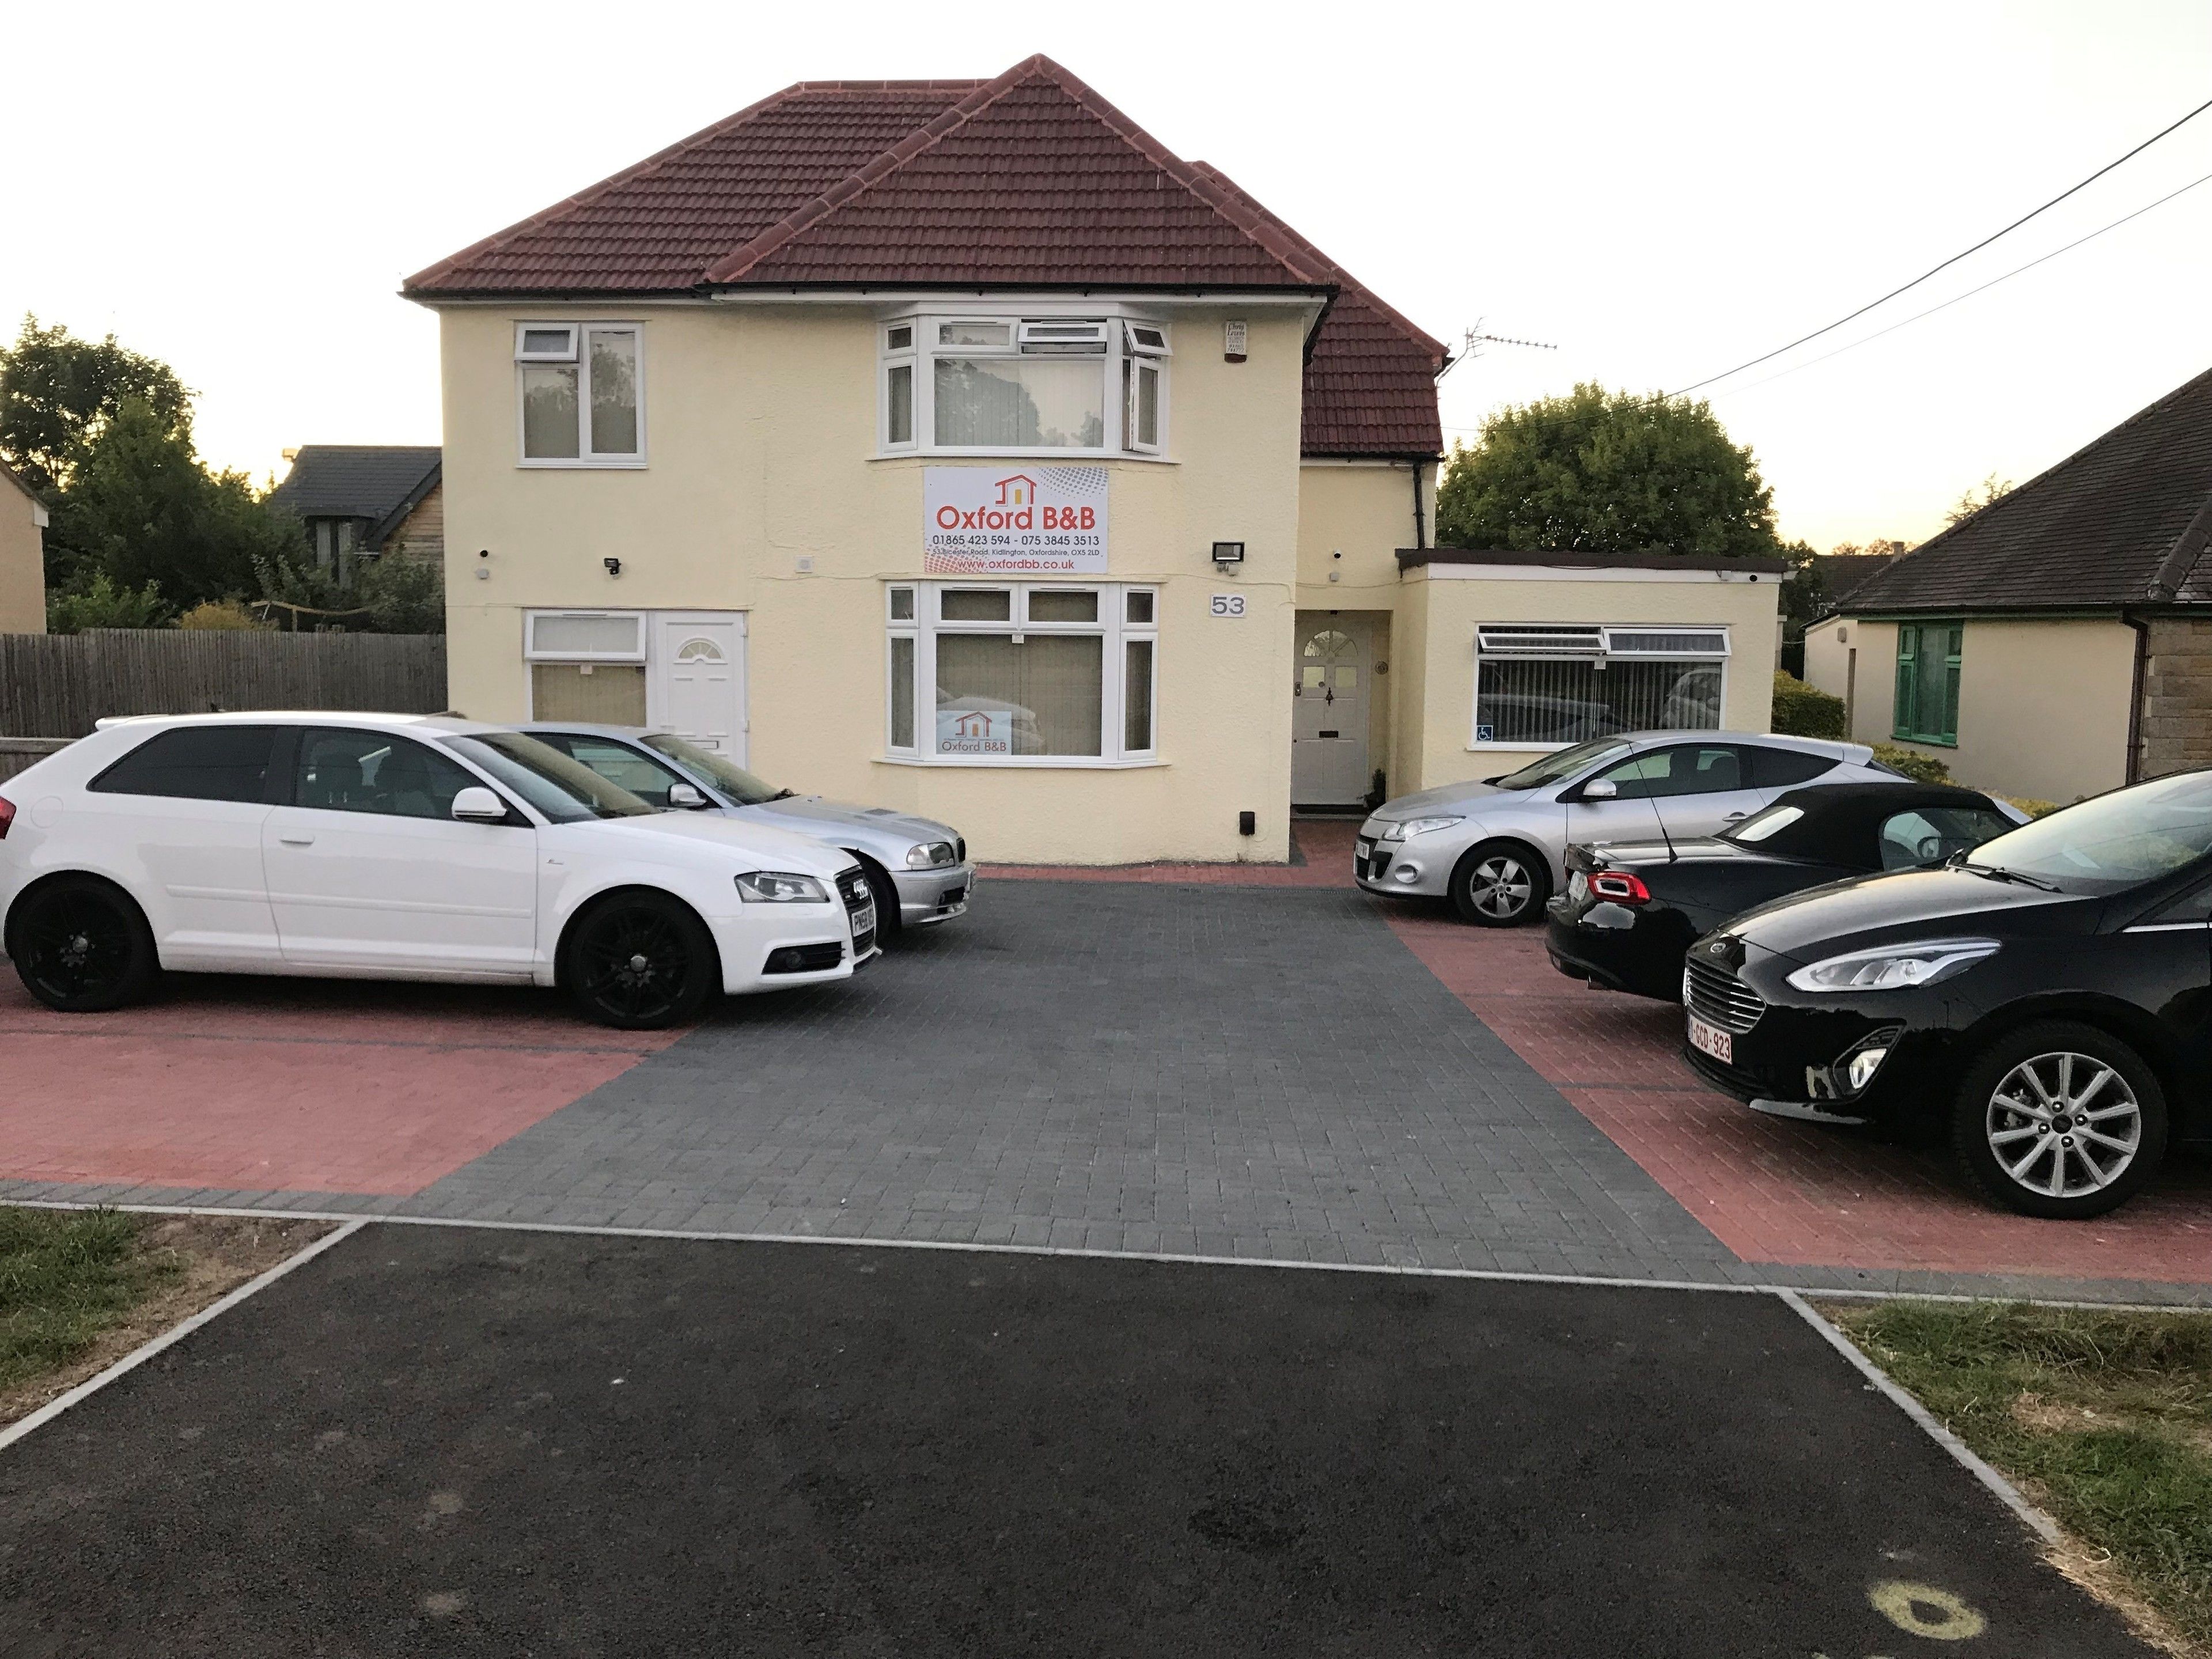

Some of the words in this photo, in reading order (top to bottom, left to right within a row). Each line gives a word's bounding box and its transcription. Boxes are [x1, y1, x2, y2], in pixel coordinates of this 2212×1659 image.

[937, 506, 1032, 530] Oxford
[1043, 507, 1096, 530] B&B
[933, 535, 965, 545] 01865
[968, 535, 987, 545] 423
[991, 536, 1010, 545] 594
[1021, 536, 1041, 546] 075
[1044, 536, 1070, 546] 3845
[1073, 536, 1099, 546] 3513
[957, 559, 1074, 569] www.oxfordbb.co.uk
[1211, 596, 1244, 614] 53
[942, 741, 980, 751] Oxford
[984, 741, 1006, 751] B&B
